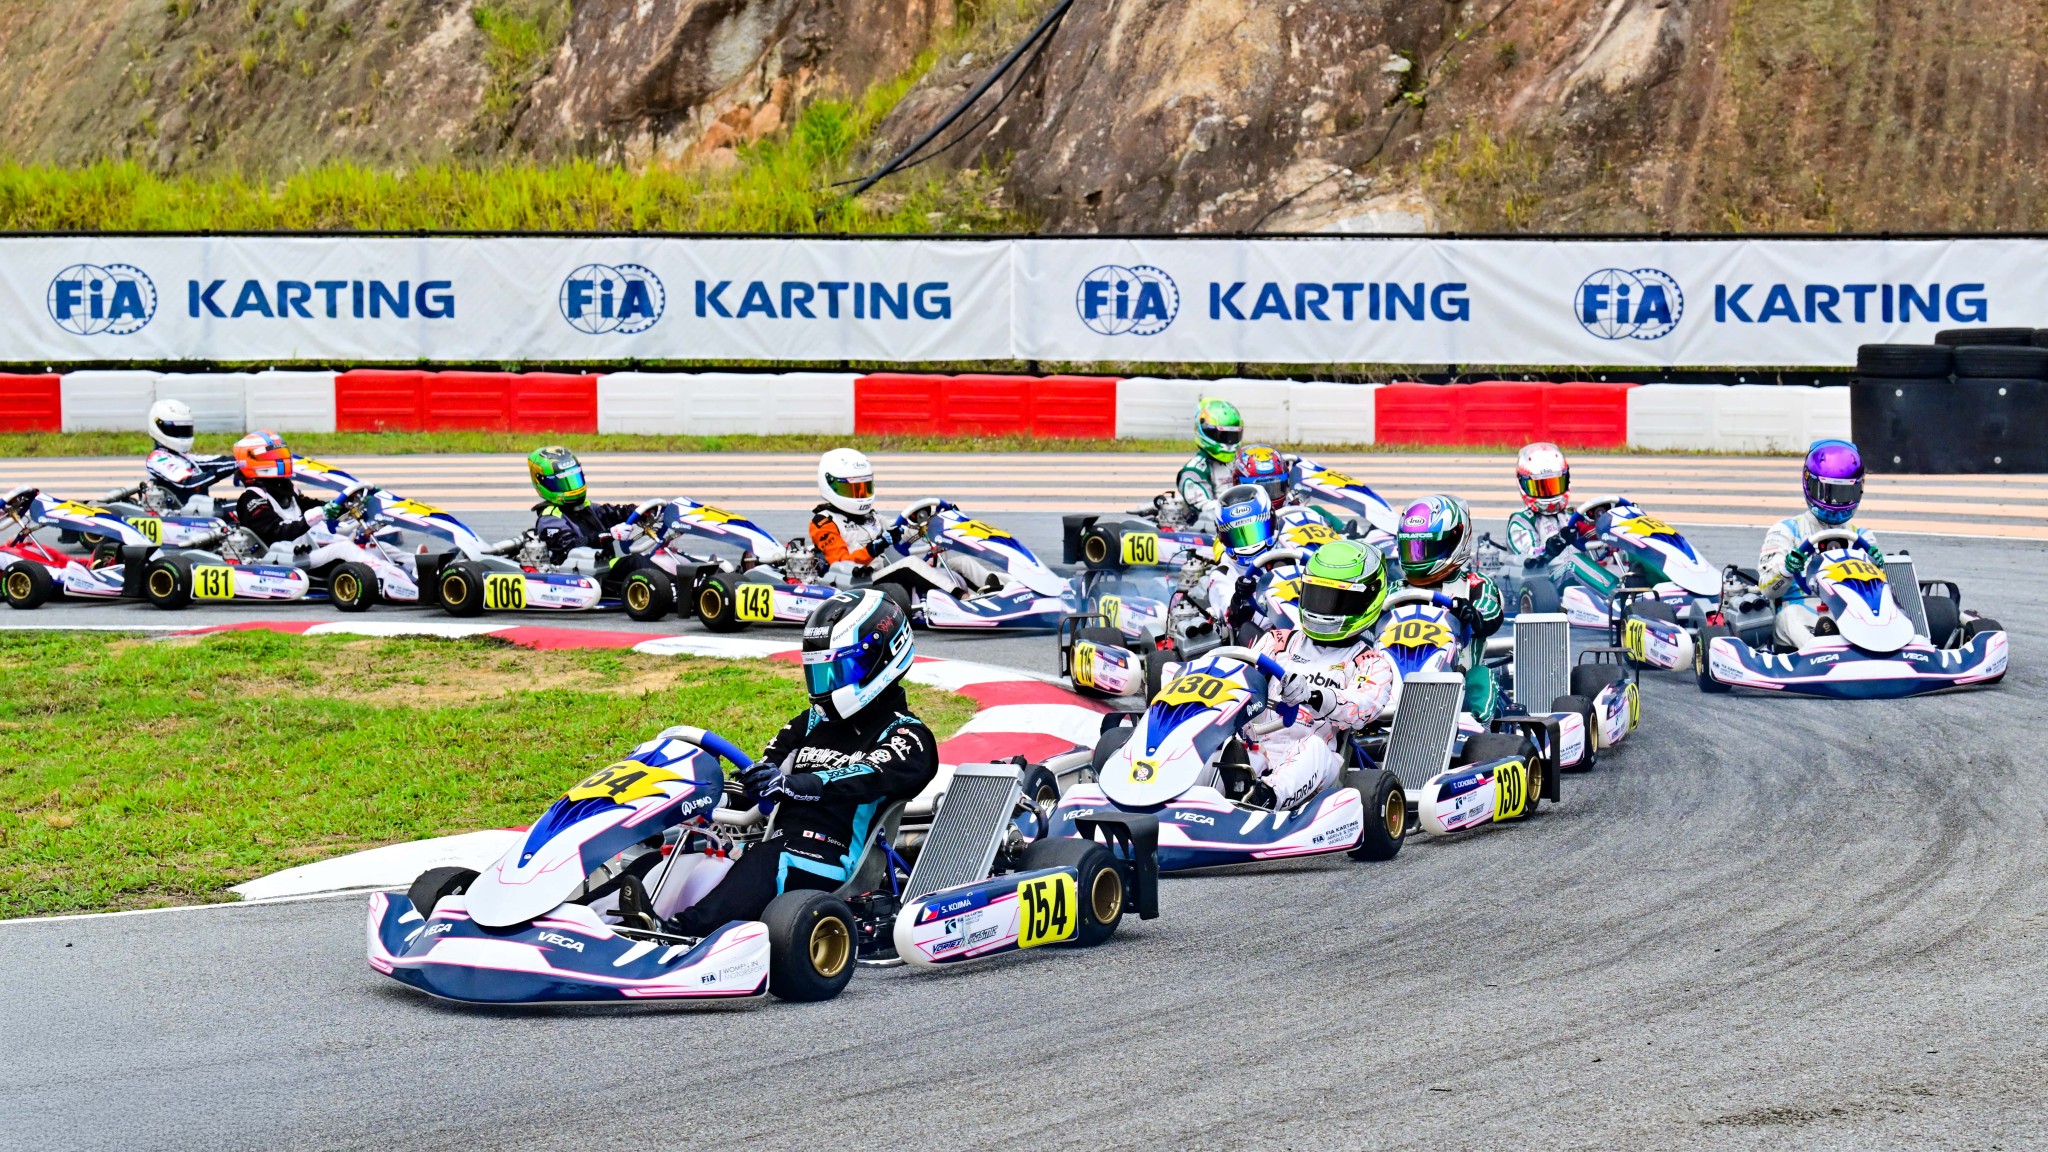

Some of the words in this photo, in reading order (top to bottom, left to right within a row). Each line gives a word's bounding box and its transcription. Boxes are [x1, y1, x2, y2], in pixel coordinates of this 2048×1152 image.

[188, 280, 455, 319] KARTING
[695, 280, 952, 320] KARTING
[1209, 282, 1470, 322] KARTING
[1715, 283, 1988, 323] KARTING
[1128, 535, 1155, 563] 150
[1837, 562, 1878, 576] 118
[200, 569, 229, 596] 131
[490, 577, 522, 608] 106
[741, 586, 770, 618] 143
[1013, 593, 1034, 604] VEGA
[1390, 622, 1442, 645] 102
[1630, 622, 1643, 658] 118
[1810, 653, 1840, 665] VEGA
[1902, 652, 1929, 662] VEGA
[1168, 676, 1223, 700] 130
[1497, 765, 1521, 817] 130
[681, 796, 713, 816] ALFNO
[1063, 808, 1094, 822] VEGA
[1174, 811, 1215, 826] VEGA
[1335, 820, 1359, 832] KARTING
[1328, 837, 1345, 845] WORLD
[1344, 832, 1354, 840] CUP
[941, 906, 948, 914] S.
[948, 899, 972, 912] KOJIMA
[1022, 878, 1068, 941] 154
[424, 924, 453, 938] VEGA
[538, 932, 585, 952] VEGA
